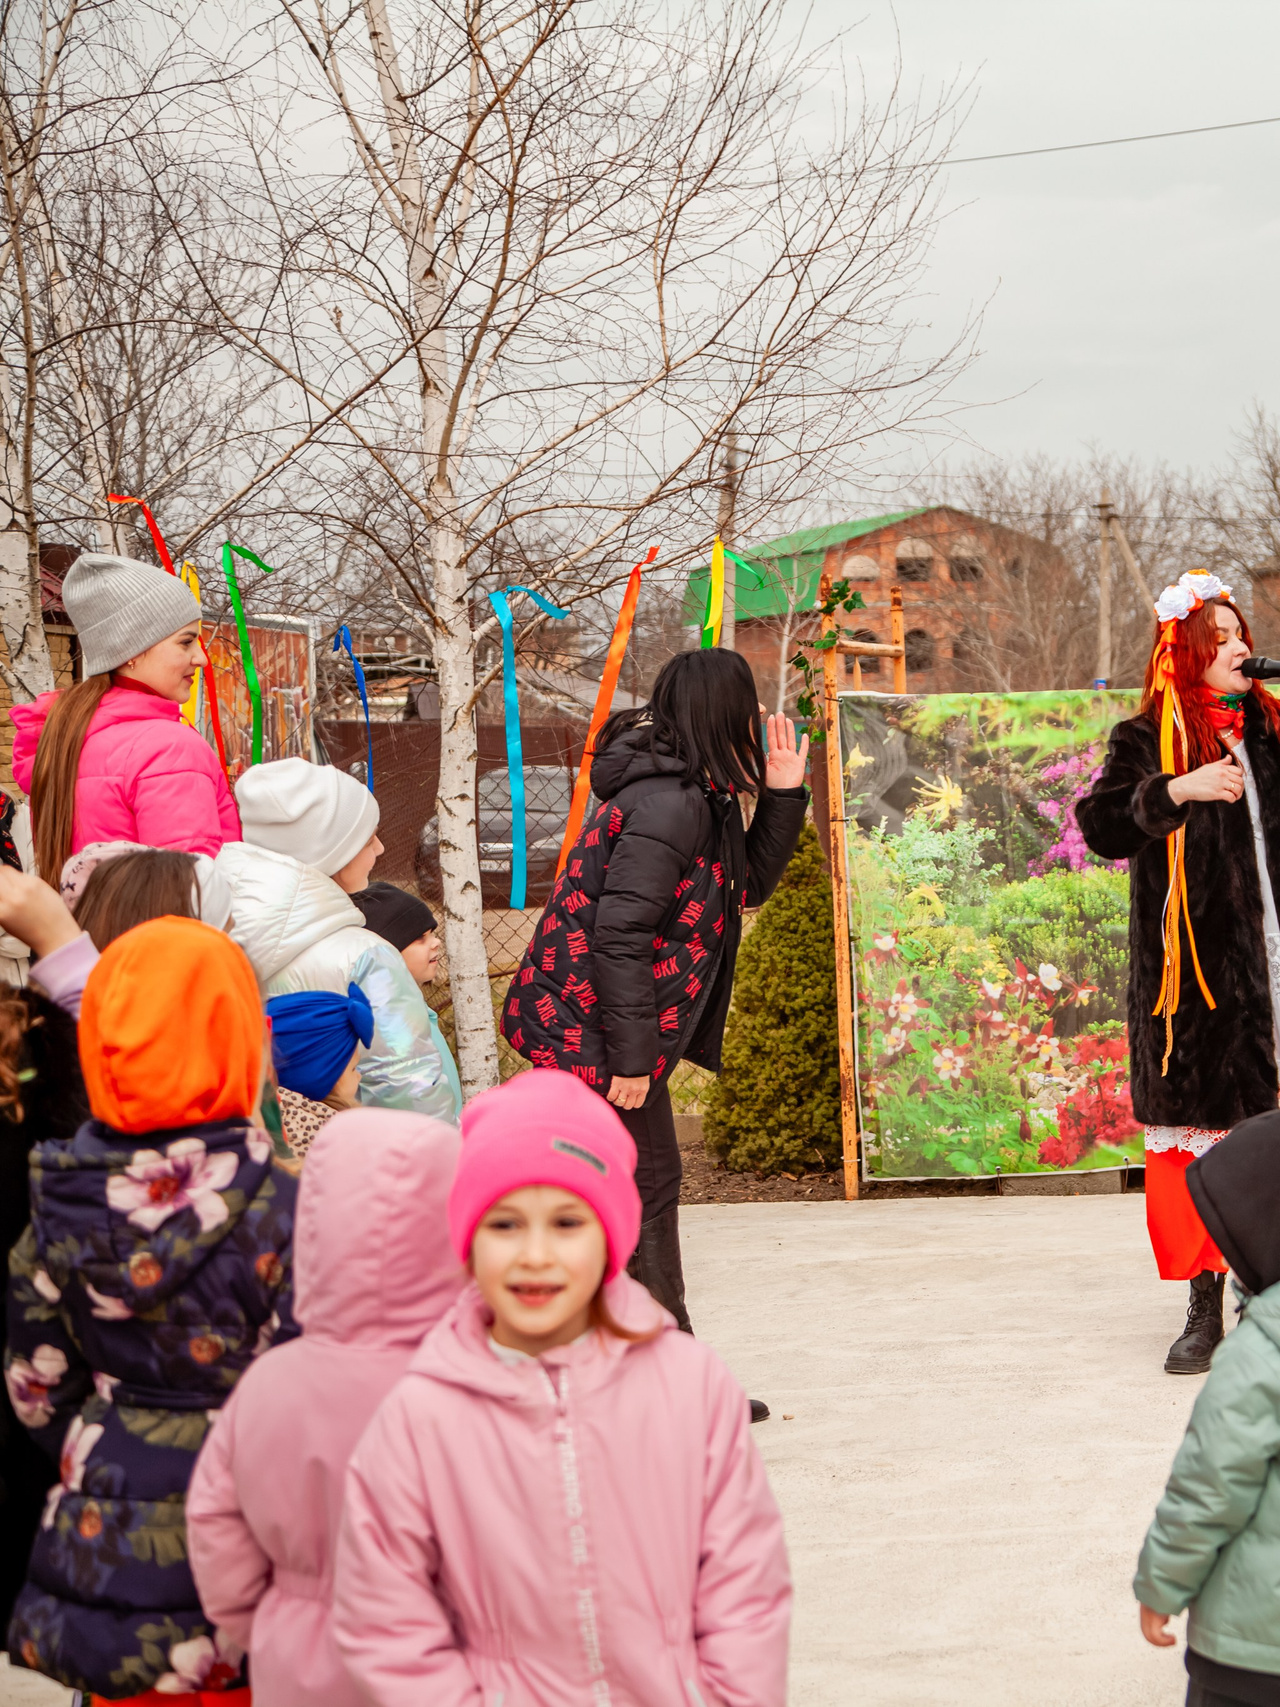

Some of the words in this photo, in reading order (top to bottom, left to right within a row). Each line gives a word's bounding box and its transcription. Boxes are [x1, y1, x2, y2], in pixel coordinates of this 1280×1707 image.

[565, 890, 591, 914] BKK
[677, 900, 704, 927] BKK
[566, 929, 589, 956] BKK
[542, 946, 557, 971] BKK
[652, 956, 680, 979] BKK
[573, 979, 598, 1008] BKK
[535, 993, 557, 1021] BKK
[563, 1028, 582, 1053] BKK
